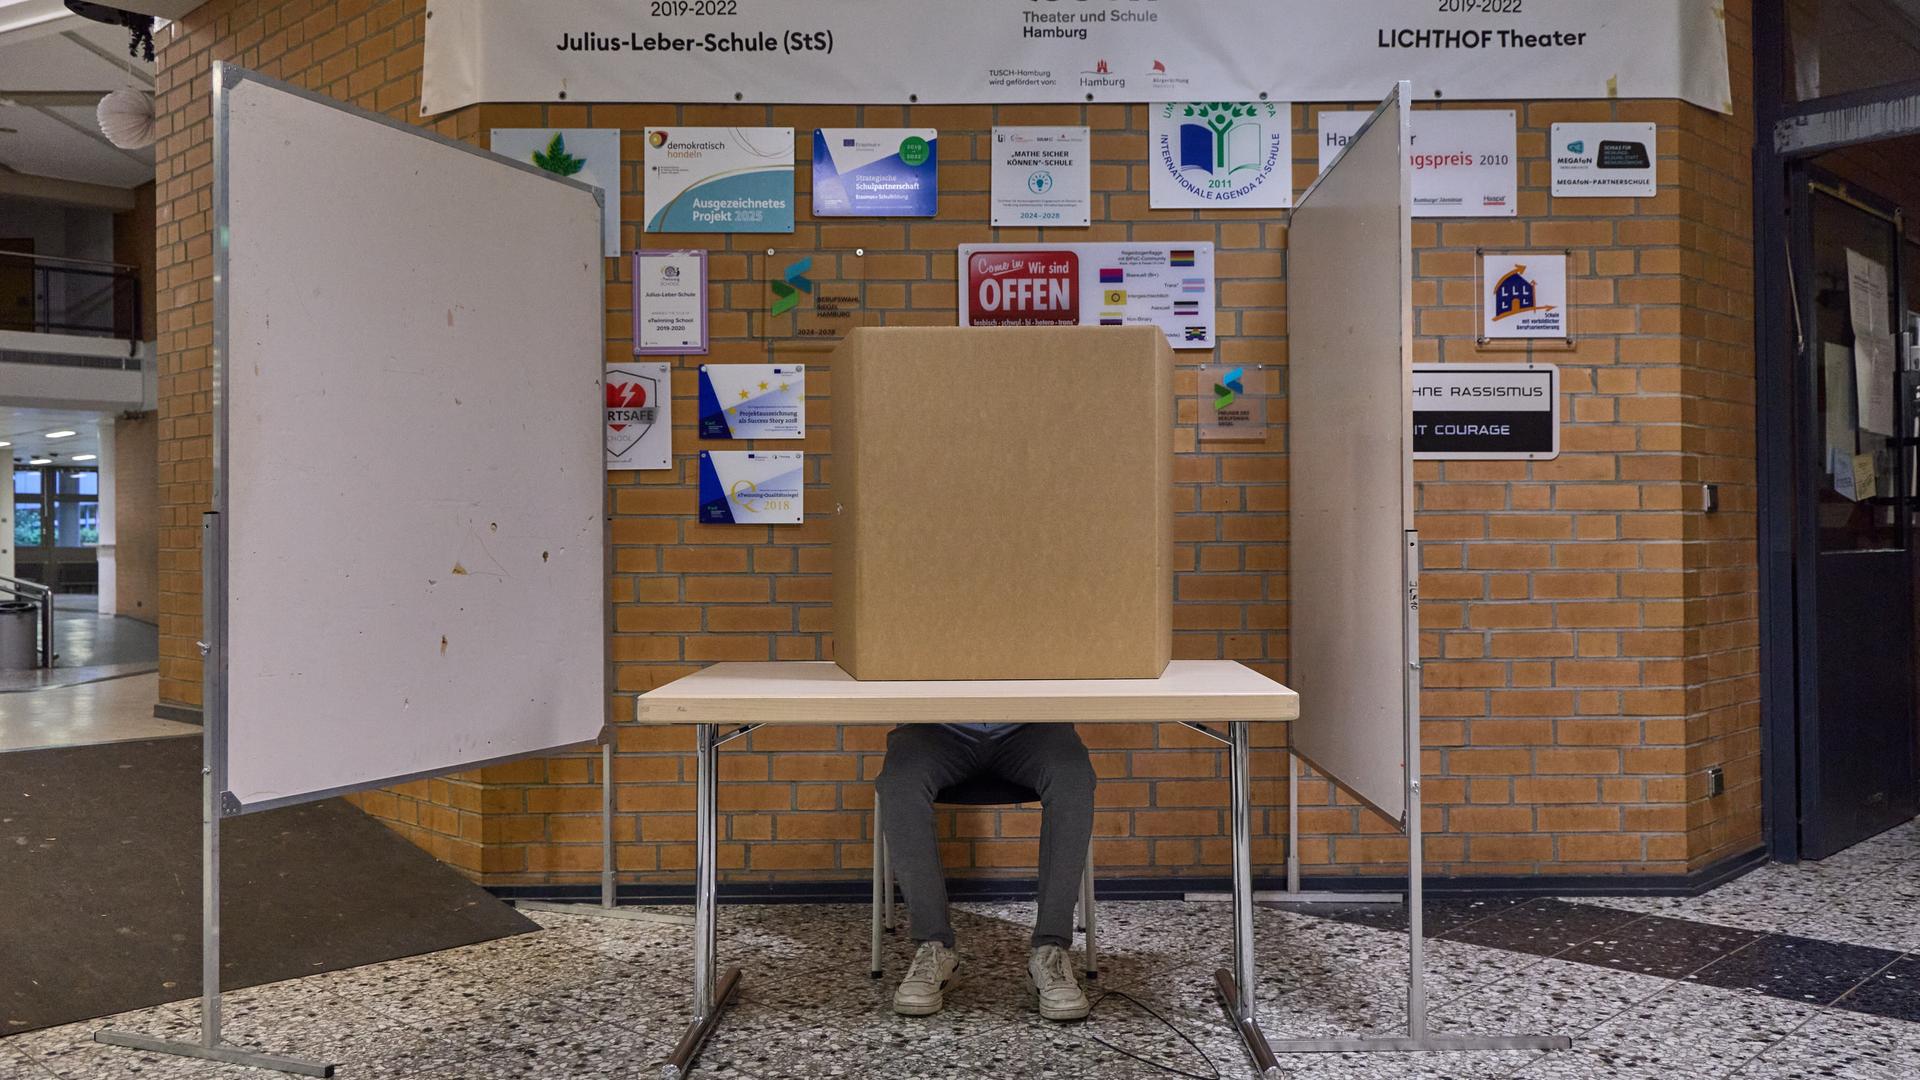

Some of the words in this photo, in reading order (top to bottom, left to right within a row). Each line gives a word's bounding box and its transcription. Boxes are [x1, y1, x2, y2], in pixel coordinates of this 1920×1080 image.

[651, 1, 737, 17] 2019-2022
[1438, 0, 1522, 13] 2019-2022
[1023, 11, 1075, 23] Theater
[1080, 10, 1105, 22] und
[1110, 10, 1158, 22] Schule
[1023, 26, 1087, 40] Hamburg
[1378, 28, 1493, 48] LICHTHOF
[1497, 29, 1587, 48] Theater
[556, 31, 777, 51] Julius-Leber-Schule
[784, 30, 833, 54] (StS)
[989, 70, 1051, 78] TUSCH-Hamburg
[989, 78, 1004, 86] wird
[1005, 78, 1040, 87] gefördert
[1080, 78, 1126, 89] Hamburg
[667, 141, 725, 150] demokratisch
[667, 150, 702, 159] handeln
[1042, 150, 1069, 158] SICHER
[1410, 151, 1473, 169] gspreis
[1479, 155, 1509, 166] 2010
[1160, 134, 1213, 200] INTERNATIONALE
[1215, 183, 1257, 200] AGENDA
[1255, 133, 1280, 185] 21-SCHULE
[855, 183, 920, 192] Schulpartnerschaft
[1208, 179, 1232, 188] 2011
[693, 197, 786, 211] Ausgezeichnetes
[692, 211, 732, 224] Projekt
[978, 258, 1010, 274] Come
[1028, 261, 1046, 274] Wir
[1049, 261, 1070, 274] sind
[979, 278, 1070, 312] OFFEN
[1412, 386, 1442, 397] HNE
[1450, 386, 1543, 397] RASSISMUS
[607, 410, 655, 421] RTSAFE
[1414, 425, 1427, 435] IT
[1435, 425, 1510, 436] COURAGE
[764, 501, 790, 511] 2018
